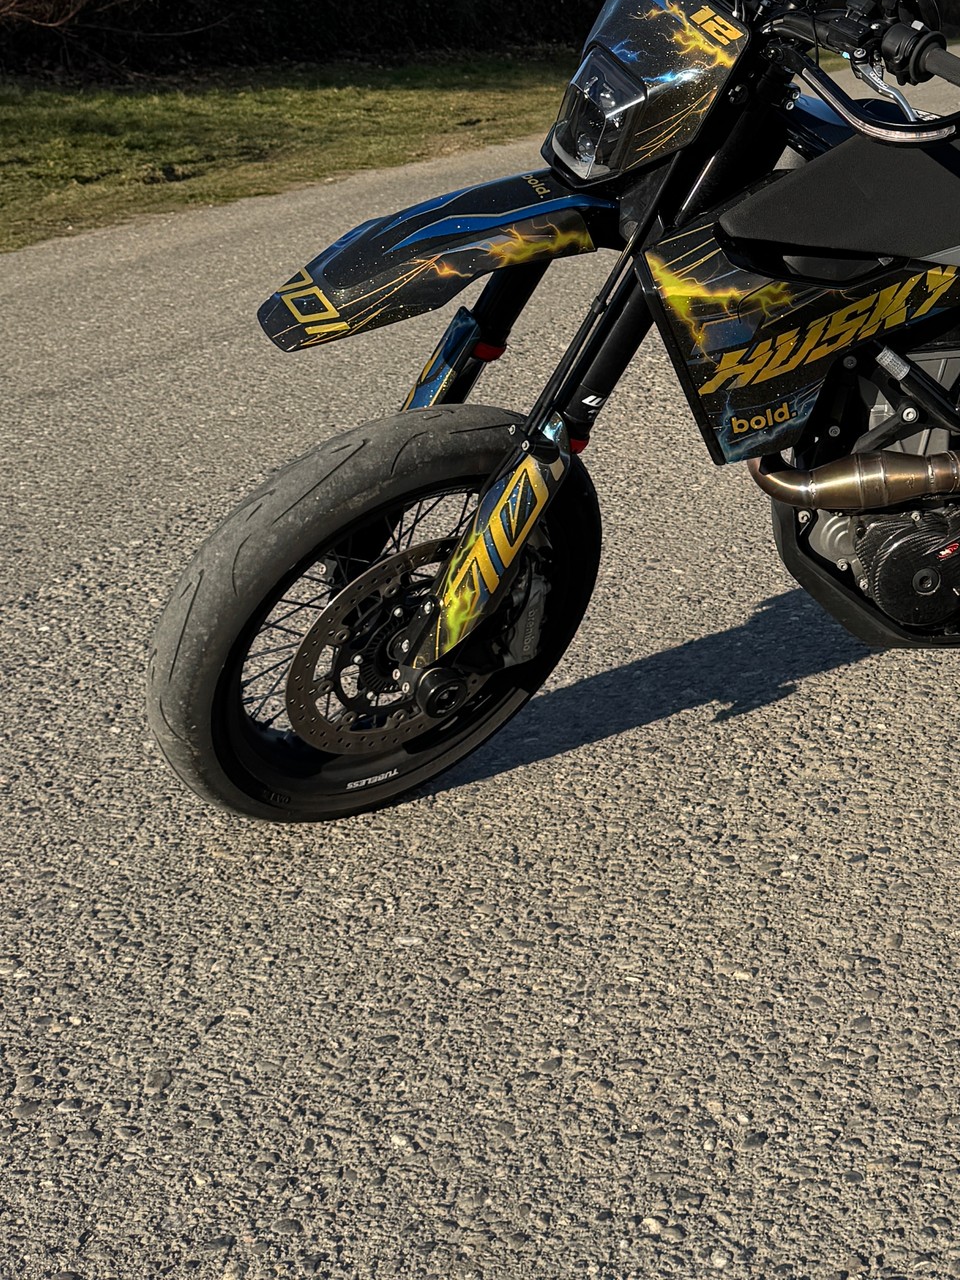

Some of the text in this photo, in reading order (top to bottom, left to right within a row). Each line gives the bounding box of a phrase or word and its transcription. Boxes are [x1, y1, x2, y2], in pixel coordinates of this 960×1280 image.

[689, 5, 744, 46] 12
[698, 265, 958, 397] HUSKY
[731, 402, 797, 434] bold.
[346, 768, 399, 790] TUBELESS
